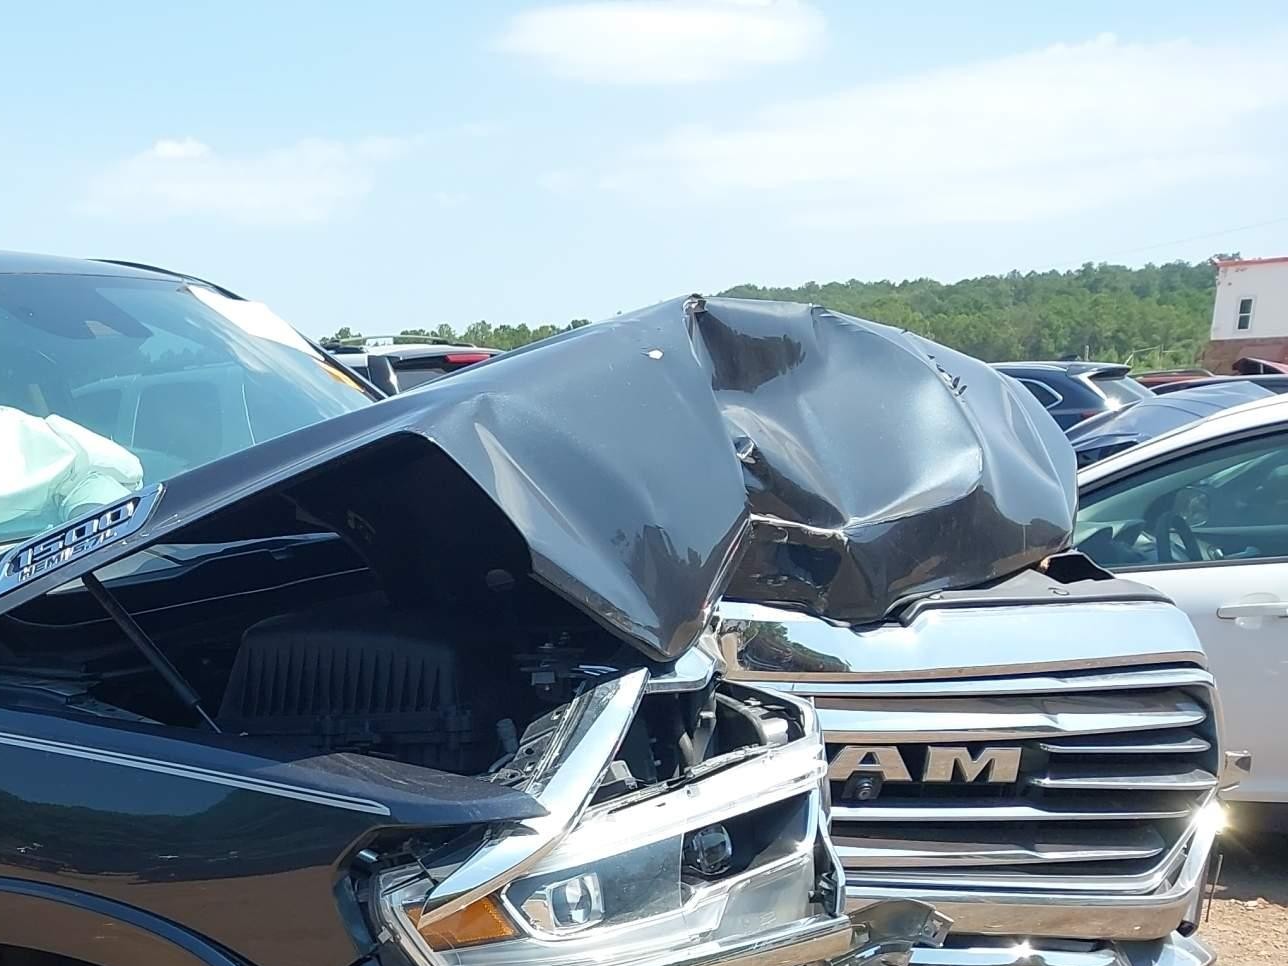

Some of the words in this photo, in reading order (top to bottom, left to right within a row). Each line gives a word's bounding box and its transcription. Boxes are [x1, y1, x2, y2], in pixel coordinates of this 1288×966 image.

[18, 501, 135, 568] 1500
[18, 547, 72, 583] HEMI
[827, 745, 1022, 783] AM
